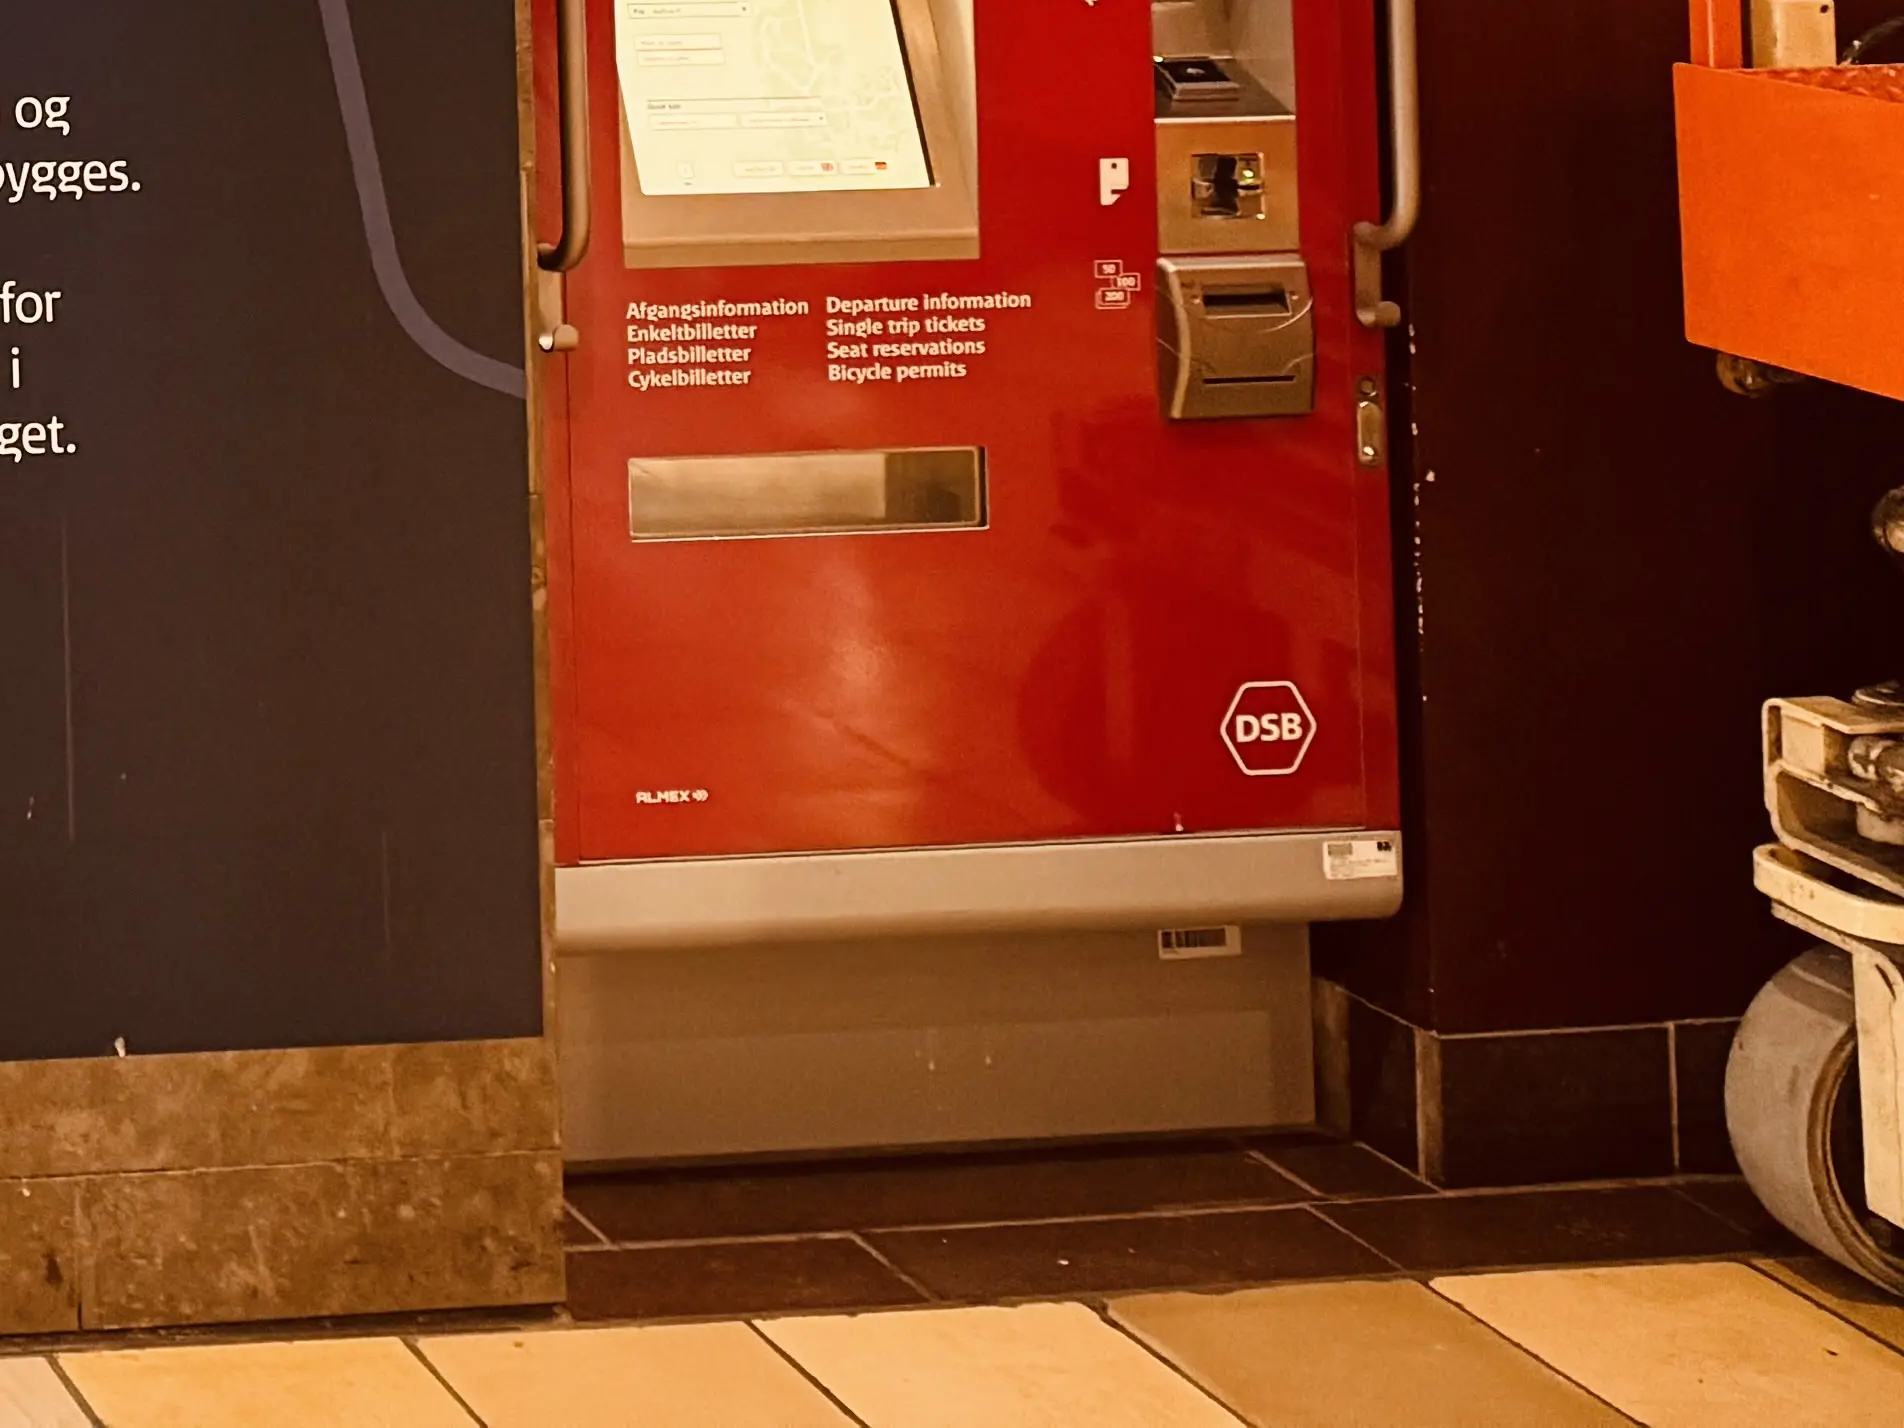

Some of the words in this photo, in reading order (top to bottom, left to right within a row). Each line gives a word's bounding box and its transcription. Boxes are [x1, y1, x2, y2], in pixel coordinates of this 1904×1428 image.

[1117, 276, 1135, 288] 100
[626, 297, 809, 320] Afgangsinformation
[826, 292, 917, 316] Departure
[922, 290, 1031, 313] information
[12, 347, 19, 388] i
[1236, 713, 1302, 742] DSB
[636, 789, 690, 803] ALMEX
